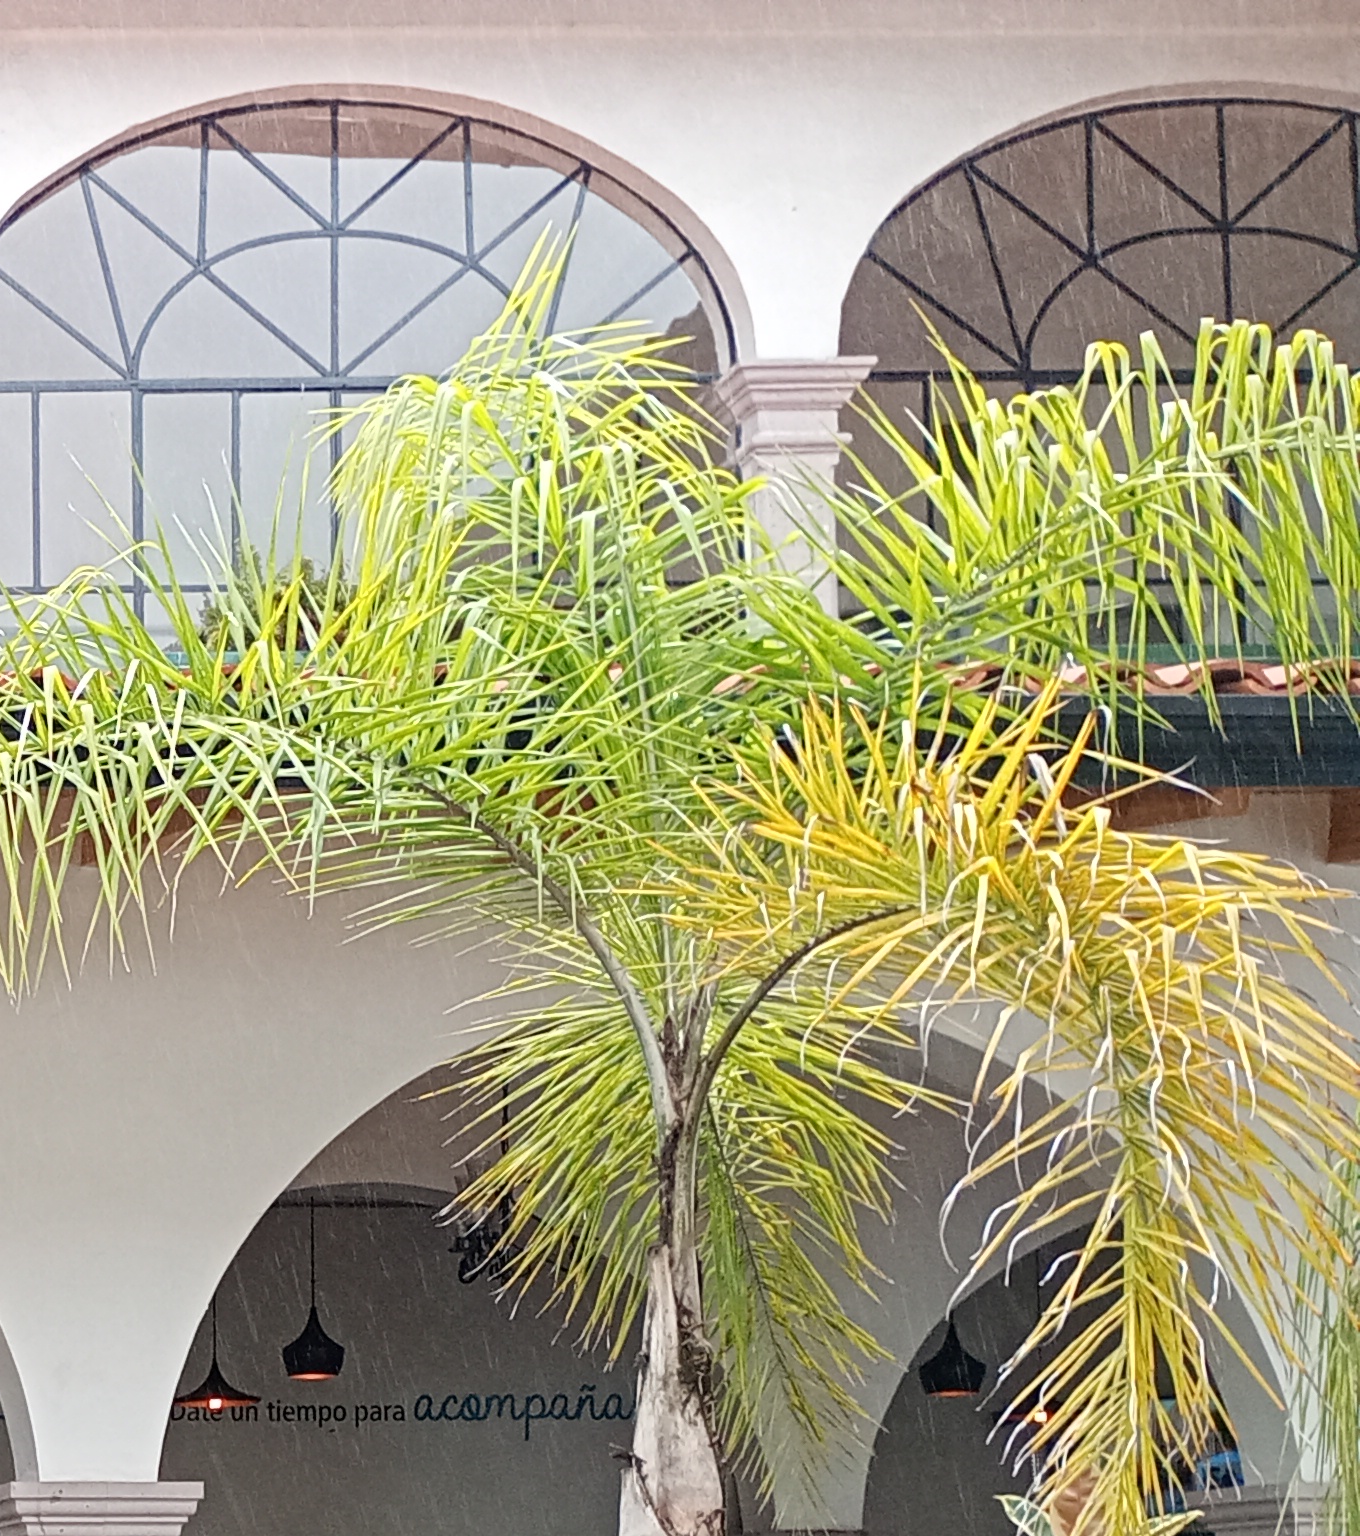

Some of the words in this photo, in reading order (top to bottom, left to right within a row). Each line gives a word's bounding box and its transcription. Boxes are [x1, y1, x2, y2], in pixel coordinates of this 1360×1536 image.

[231, 1405, 258, 1421] un
[267, 1400, 347, 1427] tiempo
[354, 1403, 406, 1428] para
